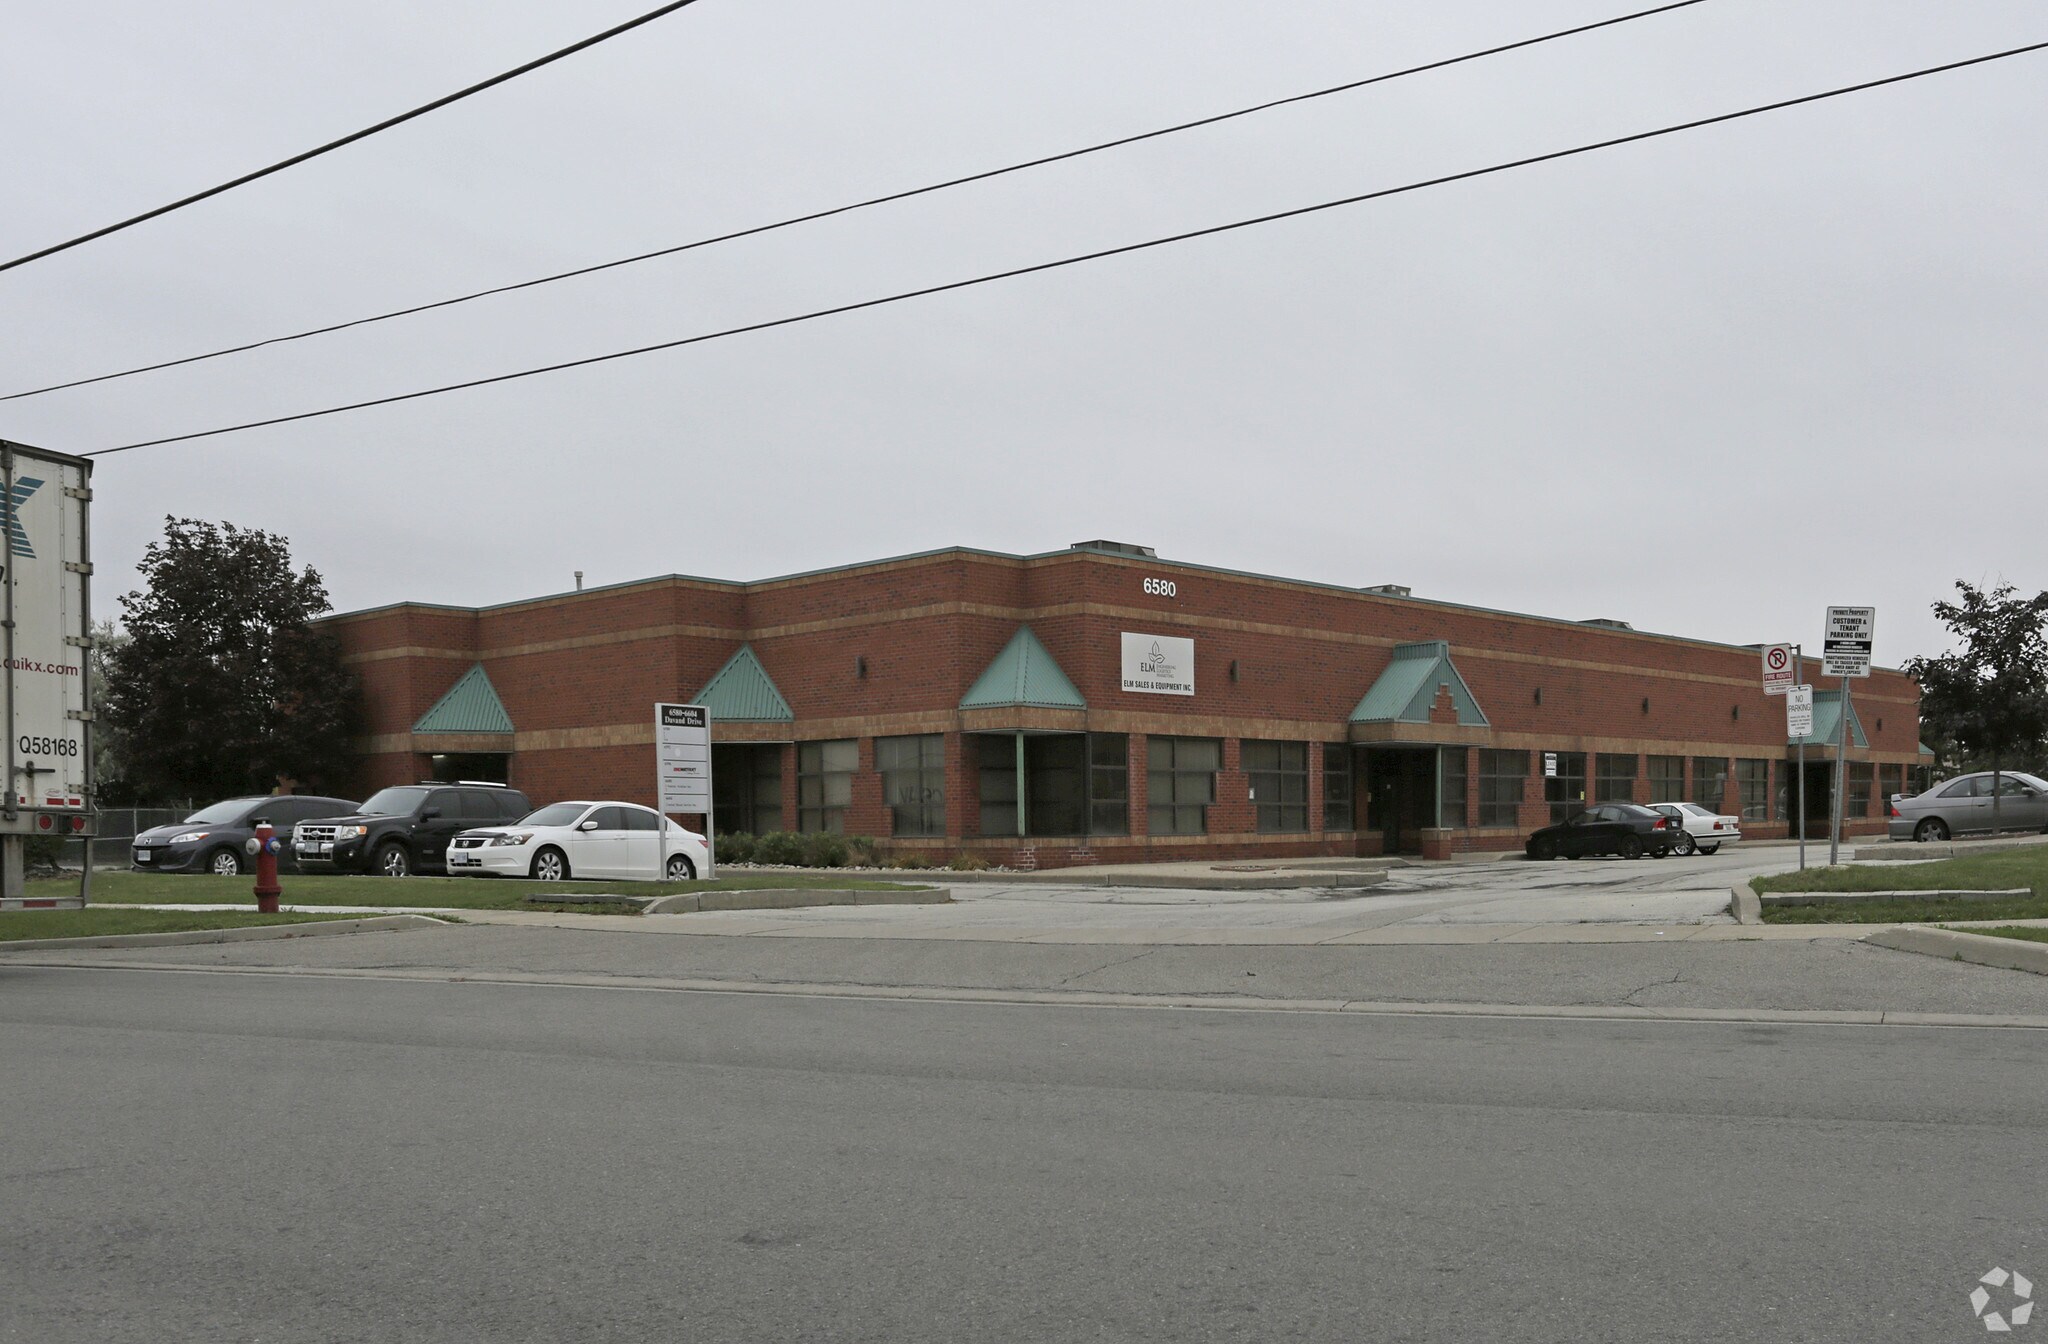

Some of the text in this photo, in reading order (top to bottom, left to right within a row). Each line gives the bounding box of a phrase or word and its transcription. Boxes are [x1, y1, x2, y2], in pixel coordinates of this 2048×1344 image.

[1143, 577, 1177, 597] 6580
[1832, 617, 1862, 625] CUSTOMER
[1140, 662, 1156, 673] ELM
[1123, 679, 1134, 688] ELM
[1134, 680, 1150, 689] SALES
[1155, 682, 1182, 691] EQUIPMENT
[1182, 683, 1193, 692] INC.
[1795, 694, 1804, 703] NO
[1788, 703, 1811, 712] PARKING
[687, 717, 703, 726] Drive
[19, 735, 78, 757] Q58168
